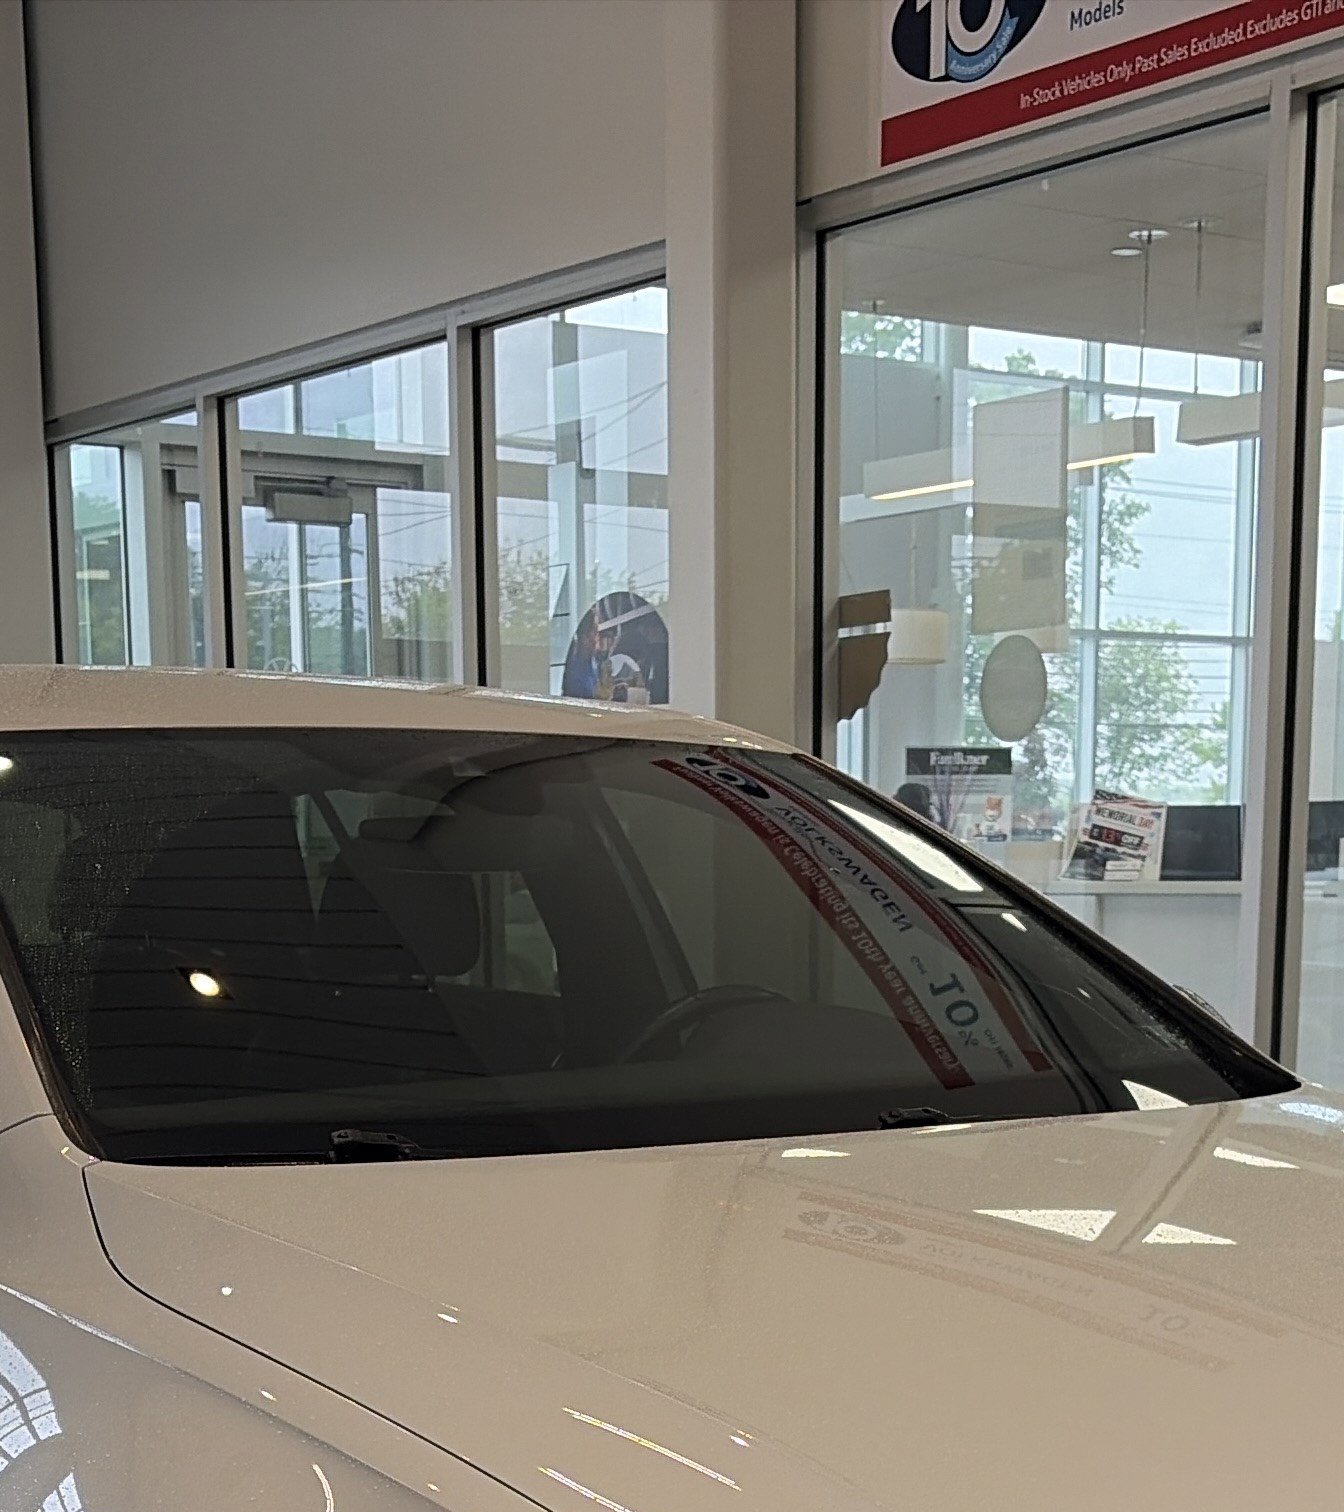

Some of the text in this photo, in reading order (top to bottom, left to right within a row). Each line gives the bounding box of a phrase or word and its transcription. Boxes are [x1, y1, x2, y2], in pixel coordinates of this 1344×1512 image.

[1069, 0, 1125, 31] Models
[995, 26, 1013, 52] Sale
[1019, 84, 1061, 109] In-Stock
[1062, 72, 1105, 98] Vehicles
[1135, 50, 1159, 72] Past
[1160, 42, 1189, 67] Sales
[1191, 24, 1244, 56] Excluded.
[1247, 8, 1299, 38] Excludes
[1301, 0, 1322, 21] GTI
[929, 751, 991, 767] Faulkner
